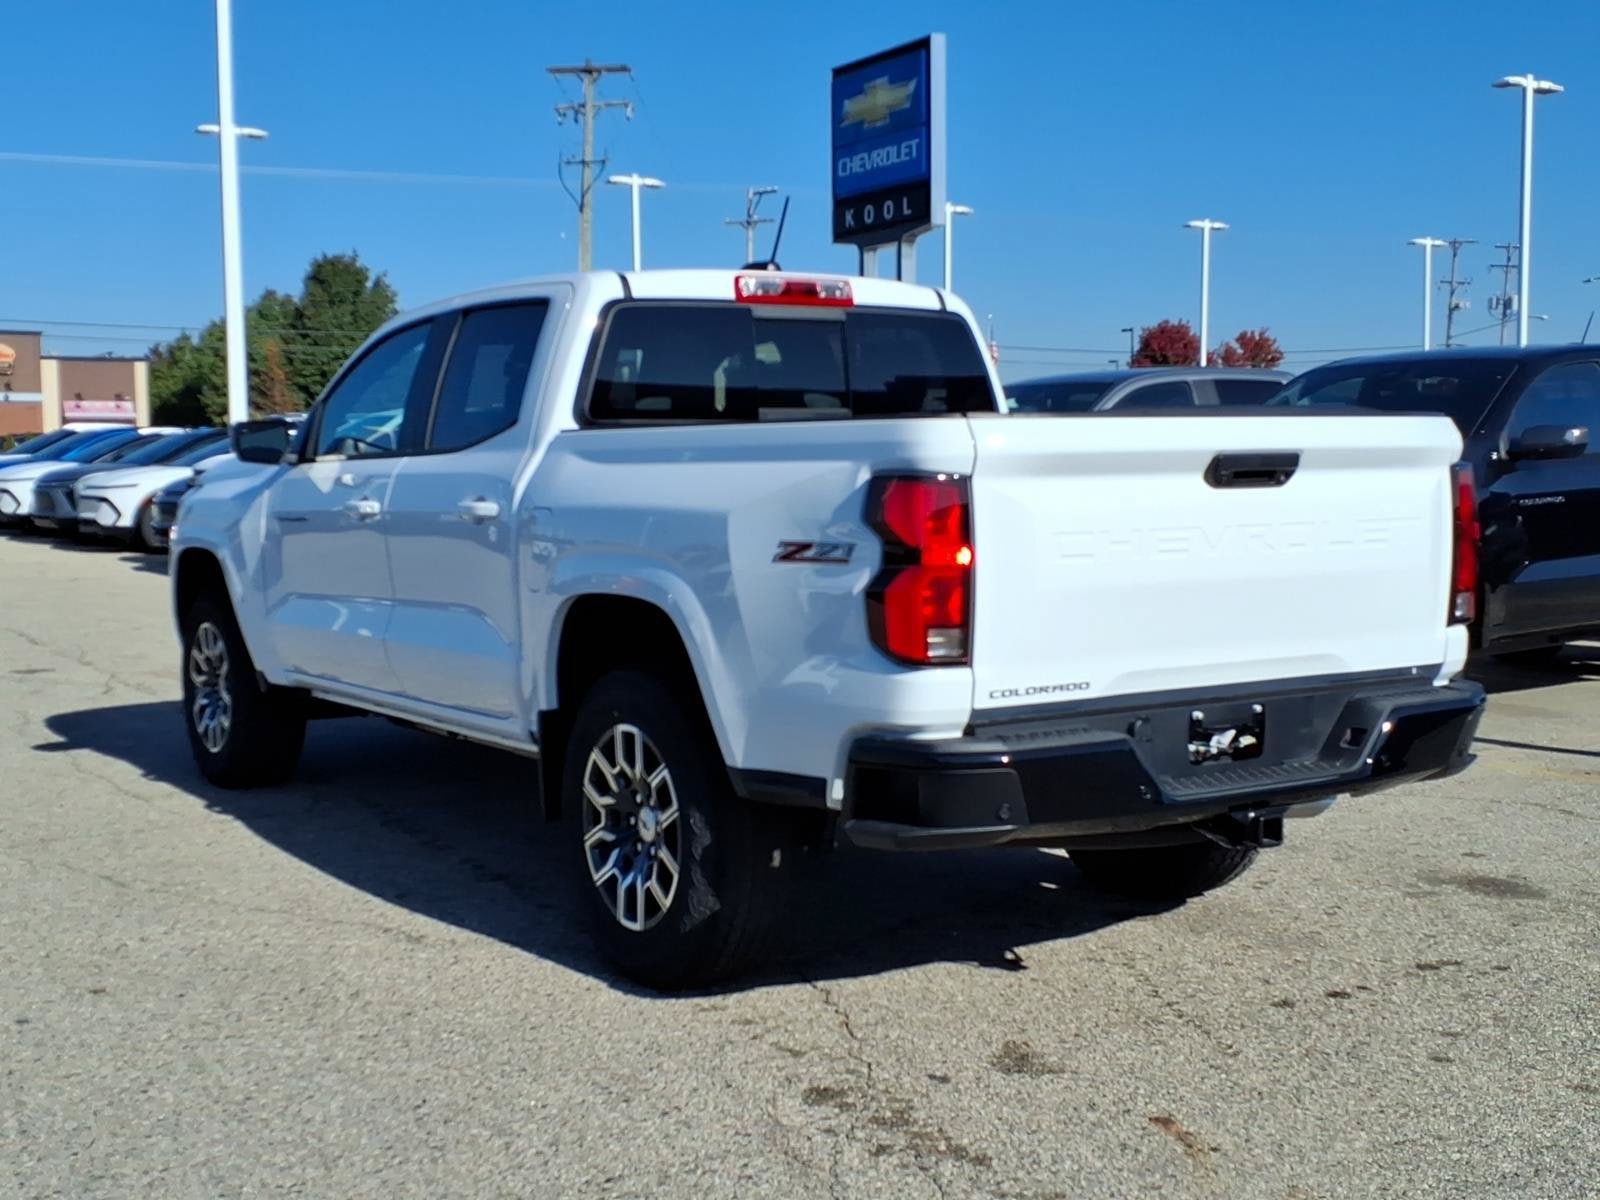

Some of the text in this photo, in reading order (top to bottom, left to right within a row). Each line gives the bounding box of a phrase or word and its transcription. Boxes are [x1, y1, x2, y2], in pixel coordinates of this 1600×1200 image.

[837, 139, 920, 177] CHEVROLET
[845, 197, 912, 228] KOOL
[772, 541, 857, 564] Z71
[989, 681, 1091, 699] COLORADO
